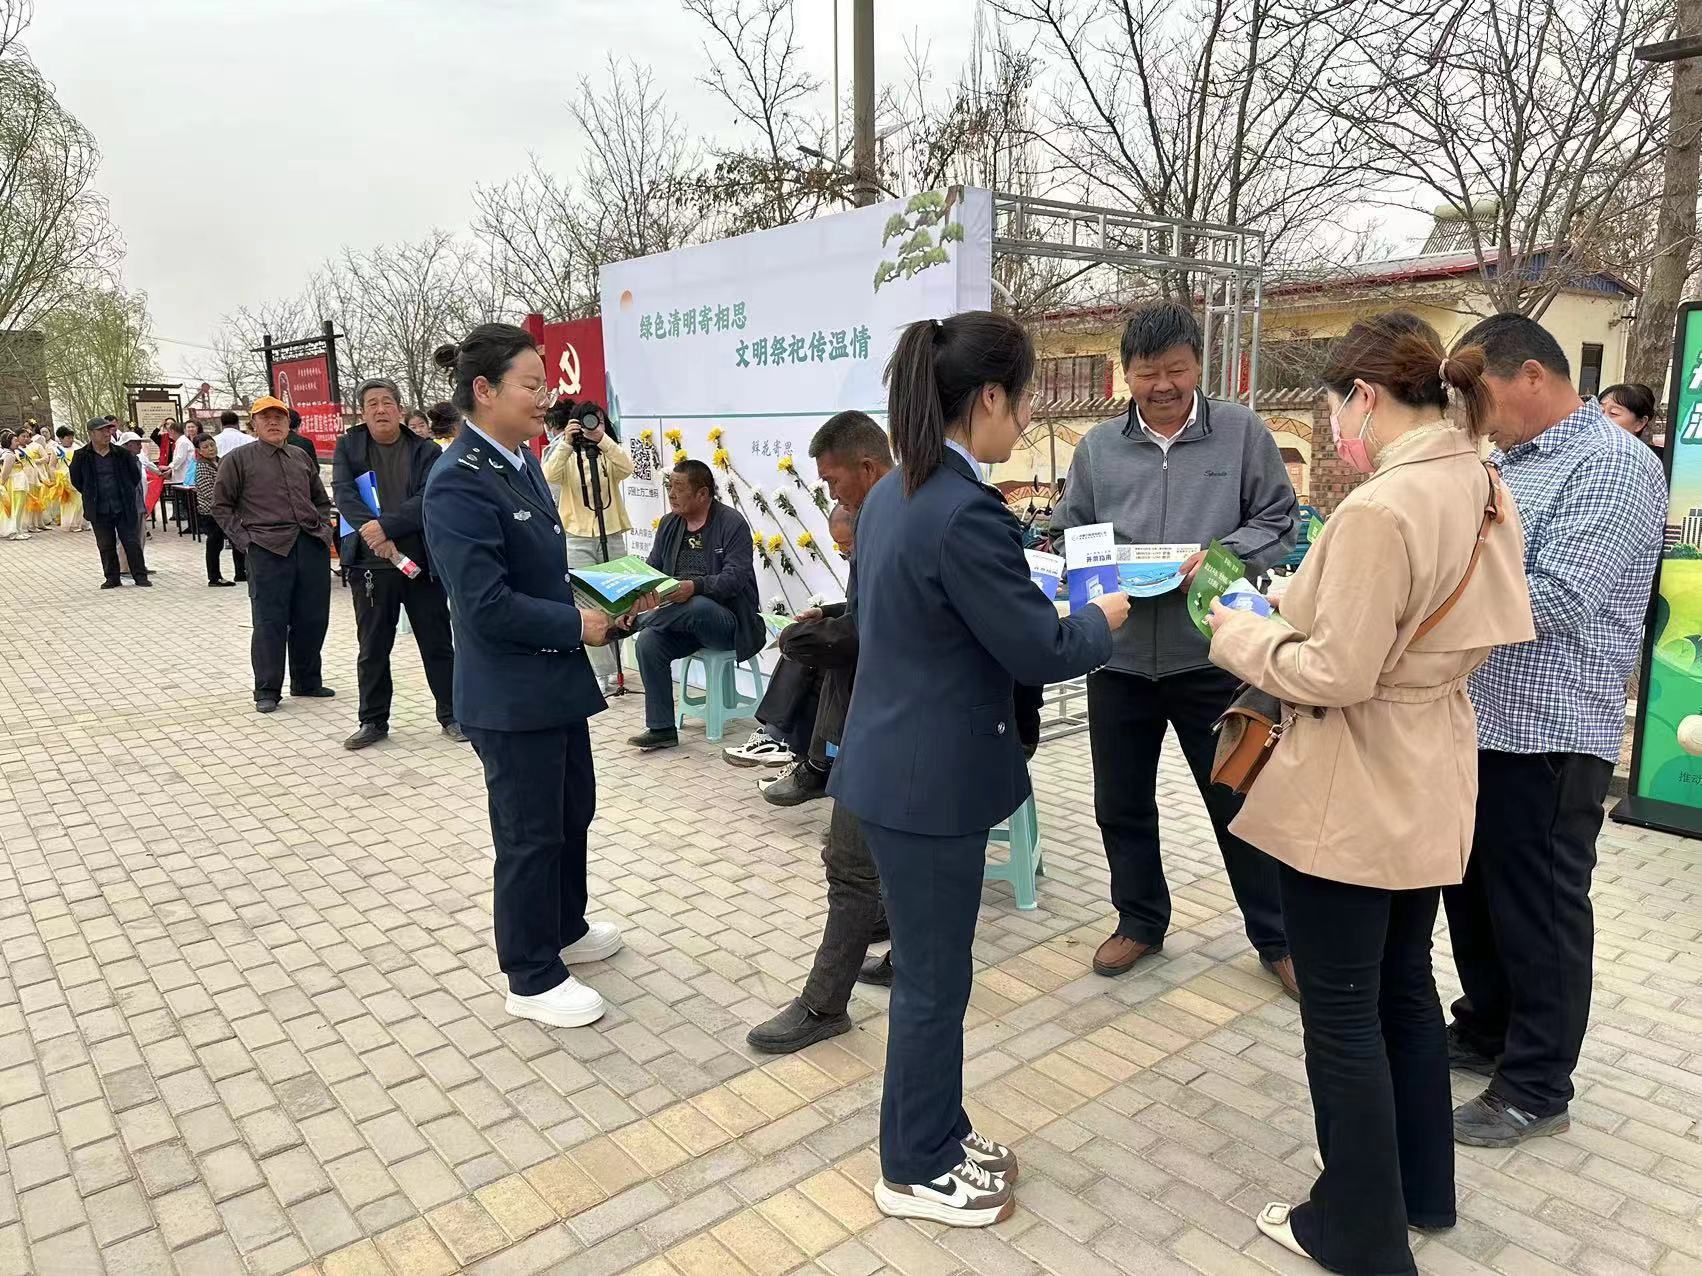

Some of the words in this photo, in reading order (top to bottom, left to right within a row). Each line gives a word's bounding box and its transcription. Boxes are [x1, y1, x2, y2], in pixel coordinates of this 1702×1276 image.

[640, 302, 748, 341] 绿色清明寄相思
[735, 324, 871, 368] 文明祭祀传温情
[752, 440, 793, 457] 鲜花寄思
